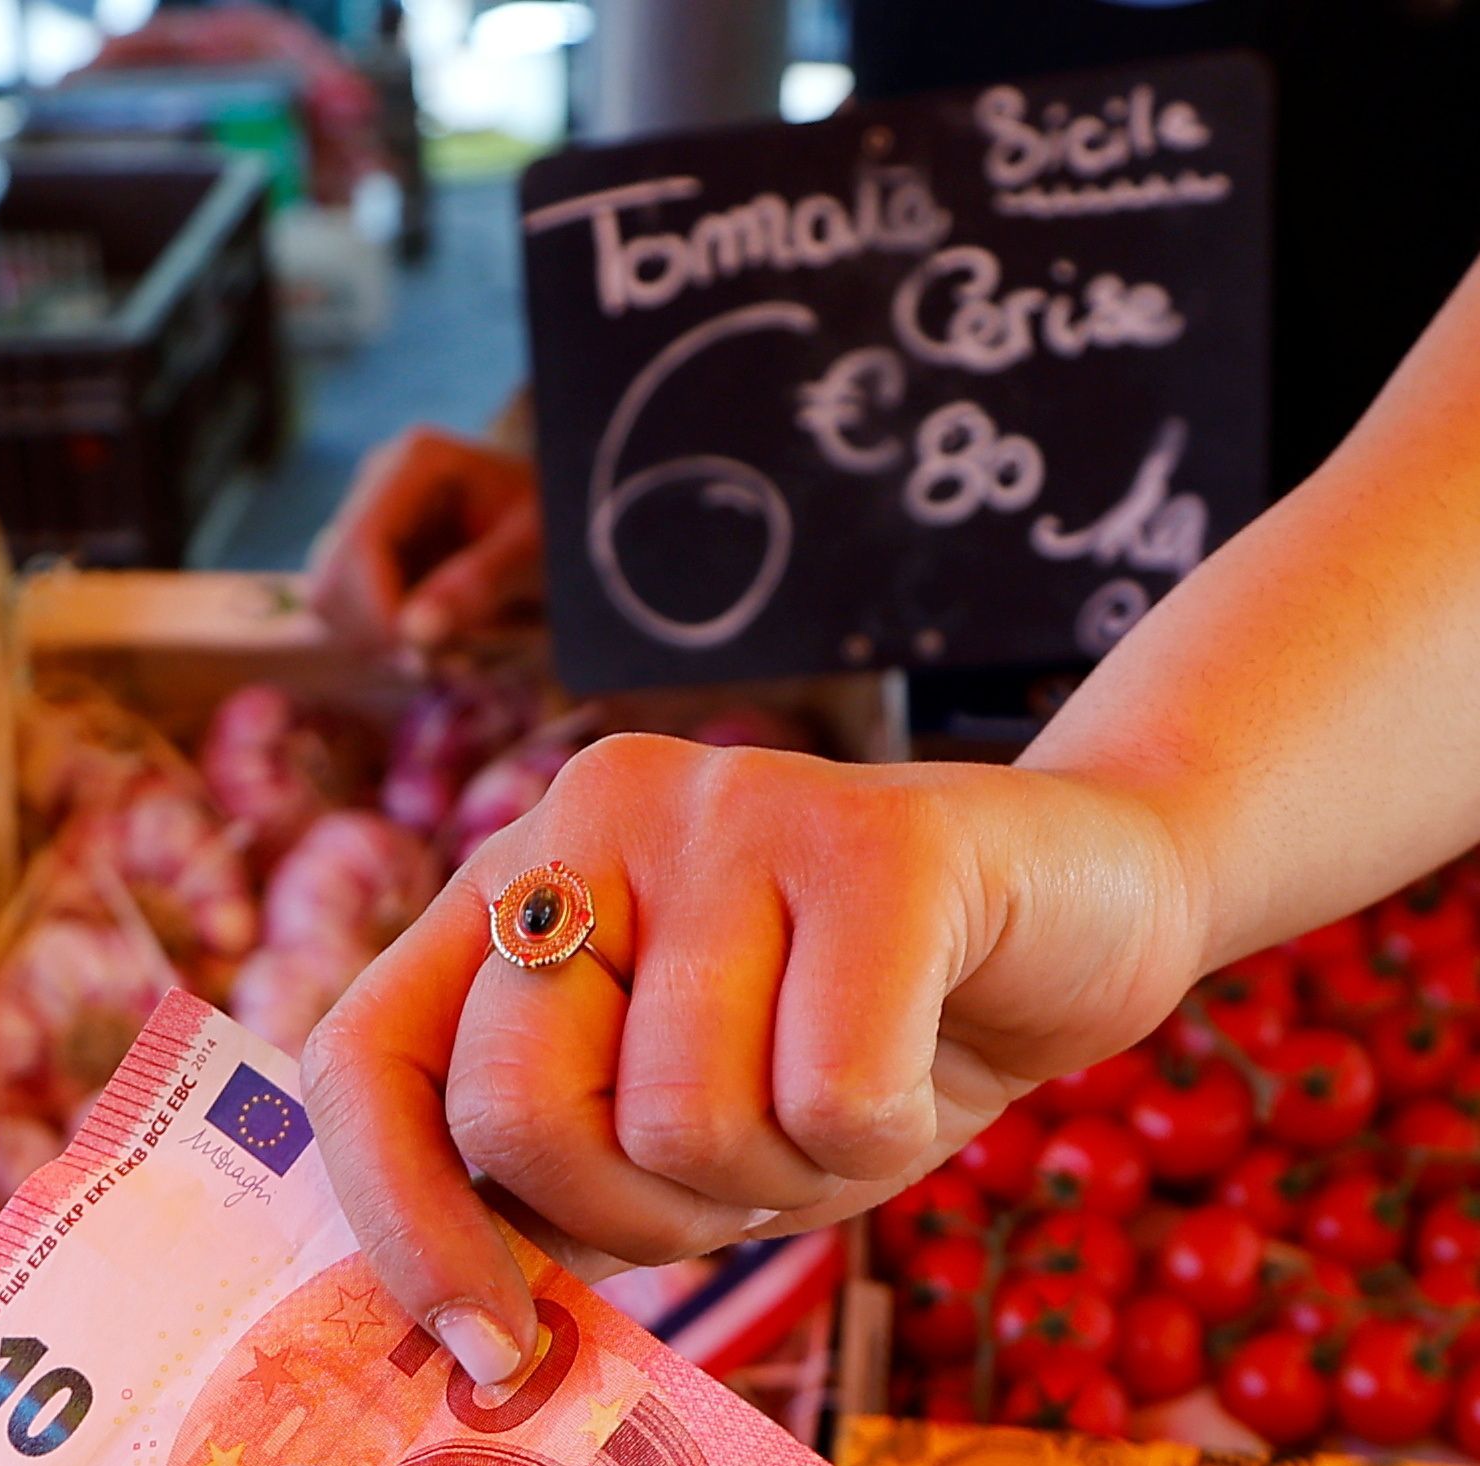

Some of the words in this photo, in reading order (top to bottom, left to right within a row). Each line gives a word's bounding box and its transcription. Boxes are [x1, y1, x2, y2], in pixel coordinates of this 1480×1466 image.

[977, 84, 1211, 187] Sicile
[893, 245, 1185, 372] Cerise
[27, 1235, 58, 1270] EZB
[115, 1149, 148, 1179] EKB
[166, 1073, 198, 1125] EBC
[191, 1037, 219, 1073] 2014
